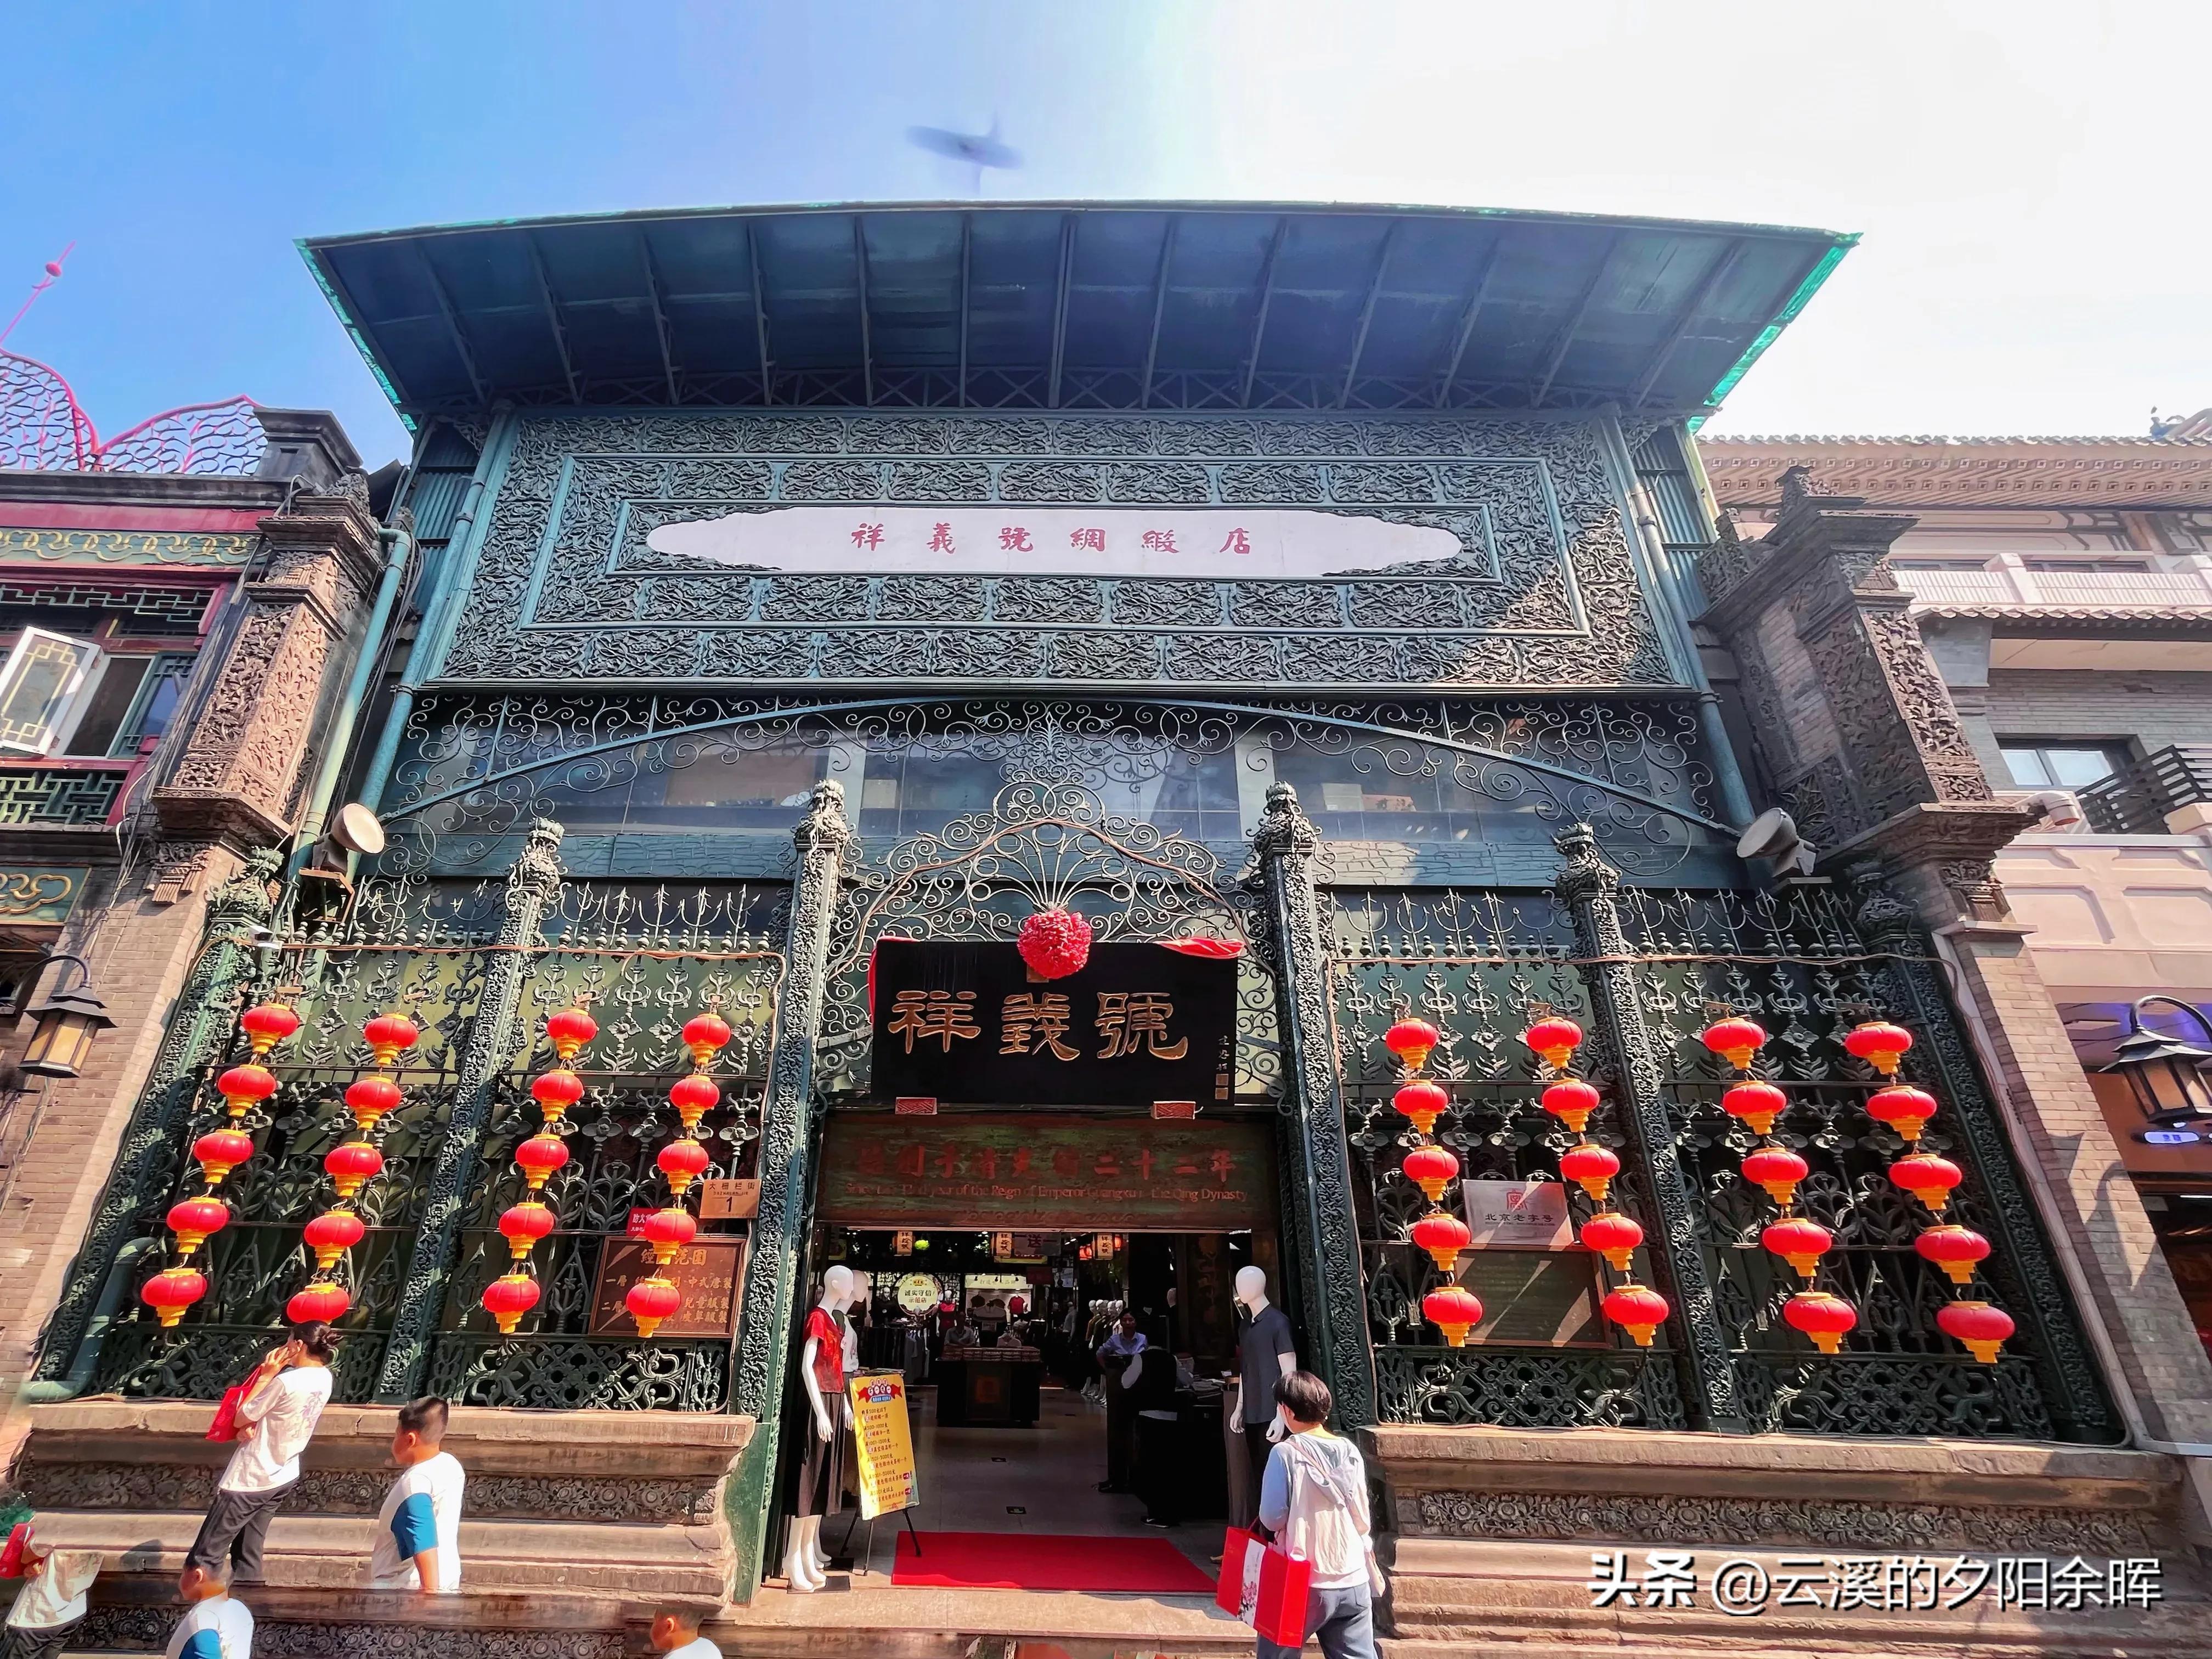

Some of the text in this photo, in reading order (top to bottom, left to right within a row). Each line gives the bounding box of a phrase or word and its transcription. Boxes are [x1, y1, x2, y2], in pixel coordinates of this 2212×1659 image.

[709, 1182, 755, 1190] 大栅栏街
[991, 1185, 1021, 1200] Reign
[1038, 1186, 1086, 1200] Emperor
[1173, 1188, 1199, 1202] Qing
[1200, 1188, 1248, 1203] Dynasty
[726, 1196, 732, 1212] 1
[1485, 1213, 1554, 1222] 北京老字号
[641, 1248, 707, 1266] 經范圍
